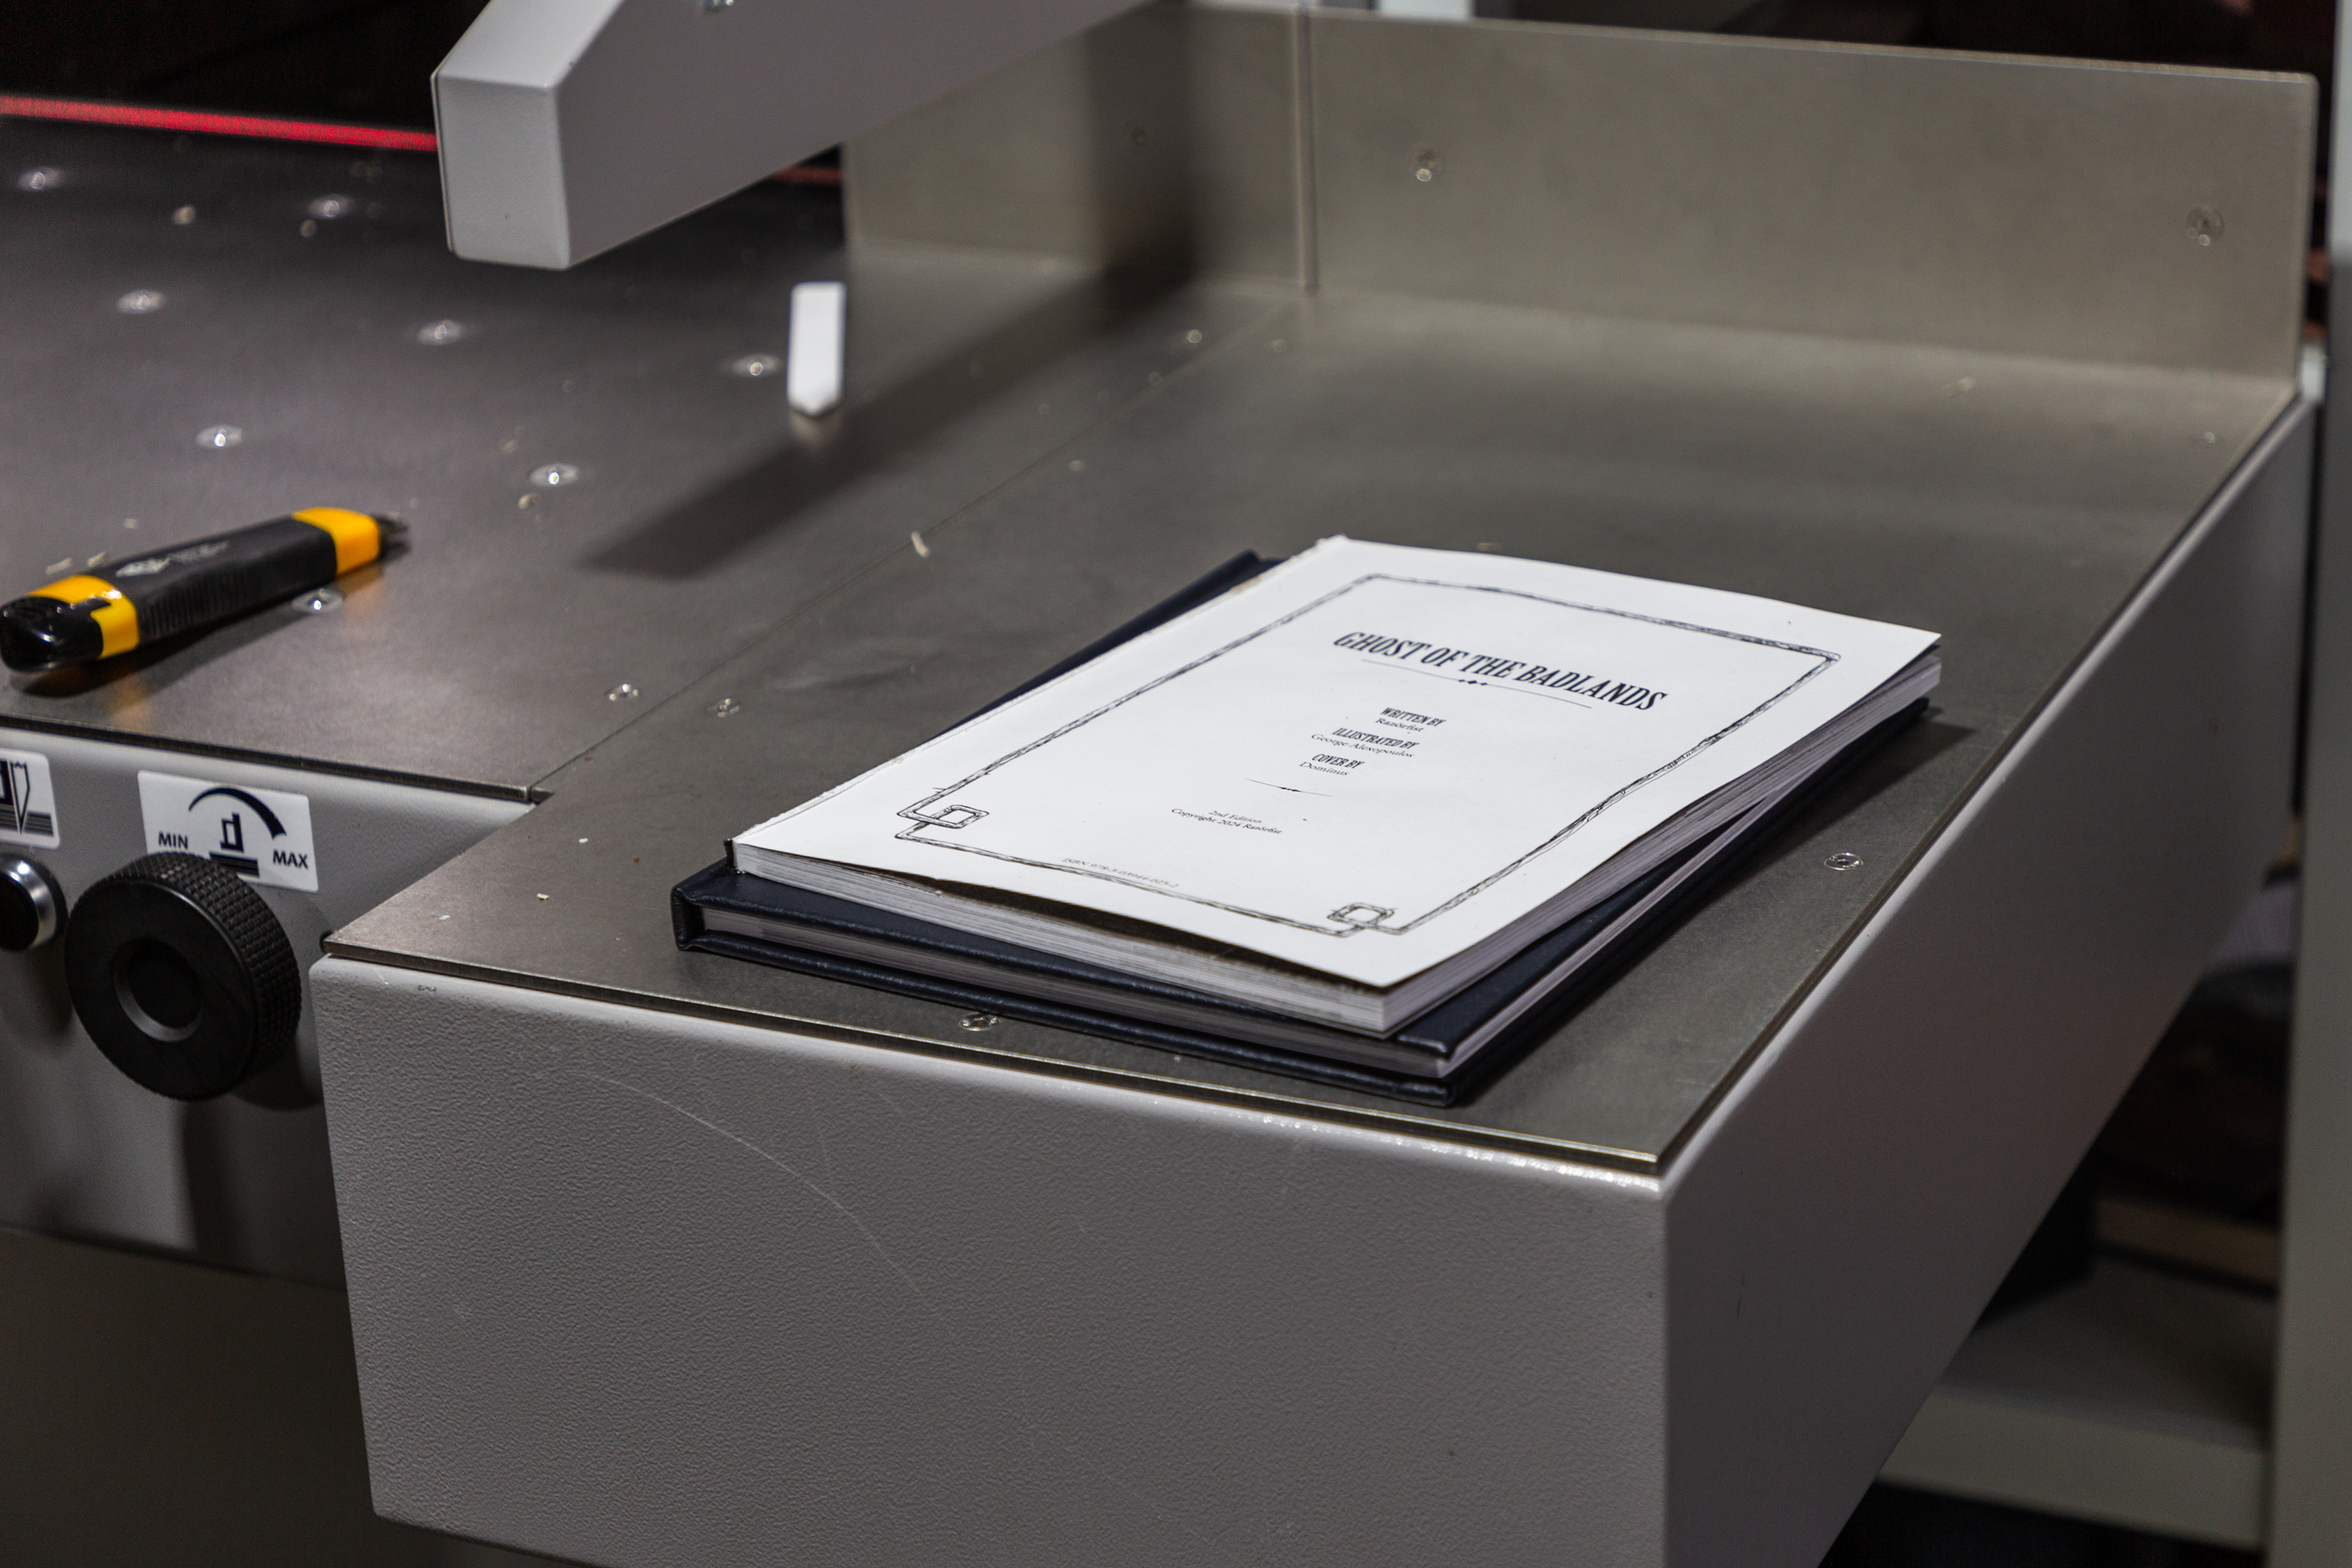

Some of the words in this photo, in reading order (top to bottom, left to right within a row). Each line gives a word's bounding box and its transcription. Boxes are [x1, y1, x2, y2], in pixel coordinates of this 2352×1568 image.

[1333, 631, 1433, 659] GHOST
[1421, 648, 1467, 668] OF
[1461, 654, 1527, 679] THE
[1515, 665, 1669, 710] BADLANDS
[1380, 706, 1432, 724] WRITTEN
[1426, 717, 1447, 727] BY
[1311, 734, 1349, 746] George
[1349, 743, 1414, 758] Alexopoulos
[1332, 728, 1404, 747] ILLUSTRATED
[1399, 741, 1421, 750] BY
[1298, 761, 1349, 776] Dominus
[1312, 753, 1350, 767] COVER
[1345, 760, 1366, 769] BY
[1171, 808, 1217, 822] Copyright
[1229, 814, 1262, 824] Edition
[158, 832, 189, 850] MIN
[272, 849, 309, 869] MAX
